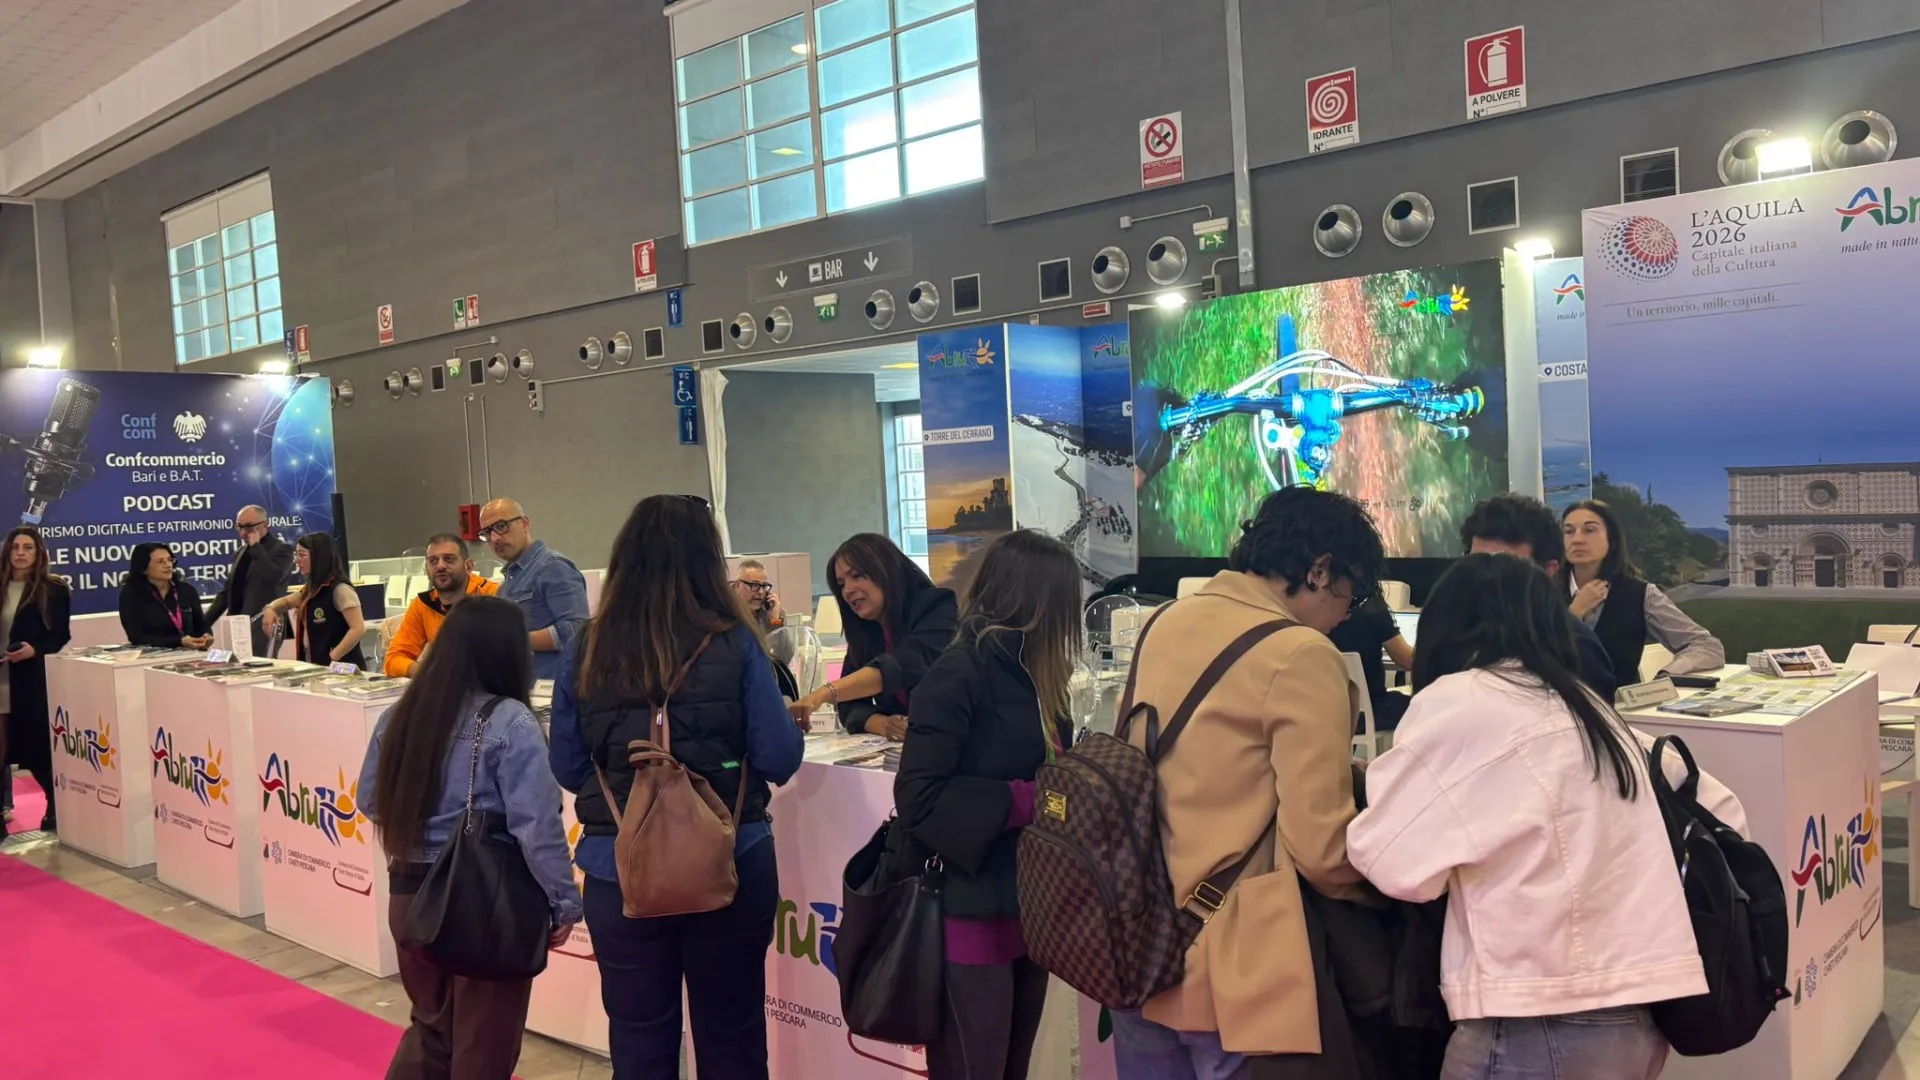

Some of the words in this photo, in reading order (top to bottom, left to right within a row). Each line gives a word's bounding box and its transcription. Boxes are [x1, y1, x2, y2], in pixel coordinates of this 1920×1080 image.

[1472, 97, 1479, 106] A
[1480, 88, 1521, 104] POLVERE
[1313, 124, 1353, 139] IDRANTE
[1691, 197, 1805, 228] L'AQUILA
[1835, 186, 1920, 232] Abr
[1691, 225, 1747, 248] 2026
[1841, 240, 1872, 253] made
[1876, 240, 1887, 250] in
[1892, 237, 1920, 247] natu
[1692, 246, 1744, 262] Capitale
[1750, 241, 1797, 255] italiana
[825, 259, 843, 280] BAR
[1692, 263, 1721, 276] della
[1725, 259, 1776, 272] Cultura
[1627, 308, 1642, 318] Un
[1645, 301, 1700, 317] territorio,
[1703, 297, 1730, 309] mille
[1732, 292, 1779, 308] capitali.
[1555, 363, 1587, 376] COSTA
[121, 413, 156, 428] Conf
[123, 428, 156, 439] com
[931, 431, 949, 441] TORRE
[950, 431, 961, 440] DEL
[963, 427, 991, 439] CERRANO
[106, 451, 226, 467] Confcommercio
[132, 470, 156, 482] Bari
[160, 473, 166, 481] e
[170, 470, 203, 481] B.A.T.
[123, 494, 215, 512] PODCAST
[88, 522, 144, 536] DIGITALE
[147, 523, 155, 533] E
[158, 519, 233, 532] PATRIMONIO
[75, 545, 137, 564] NUOV
[80, 573, 98, 590] IL
[771, 1009, 807, 1029] PESCARA
[778, 996, 788, 1010] DI
[788, 1002, 842, 1028] COMMERCIO
